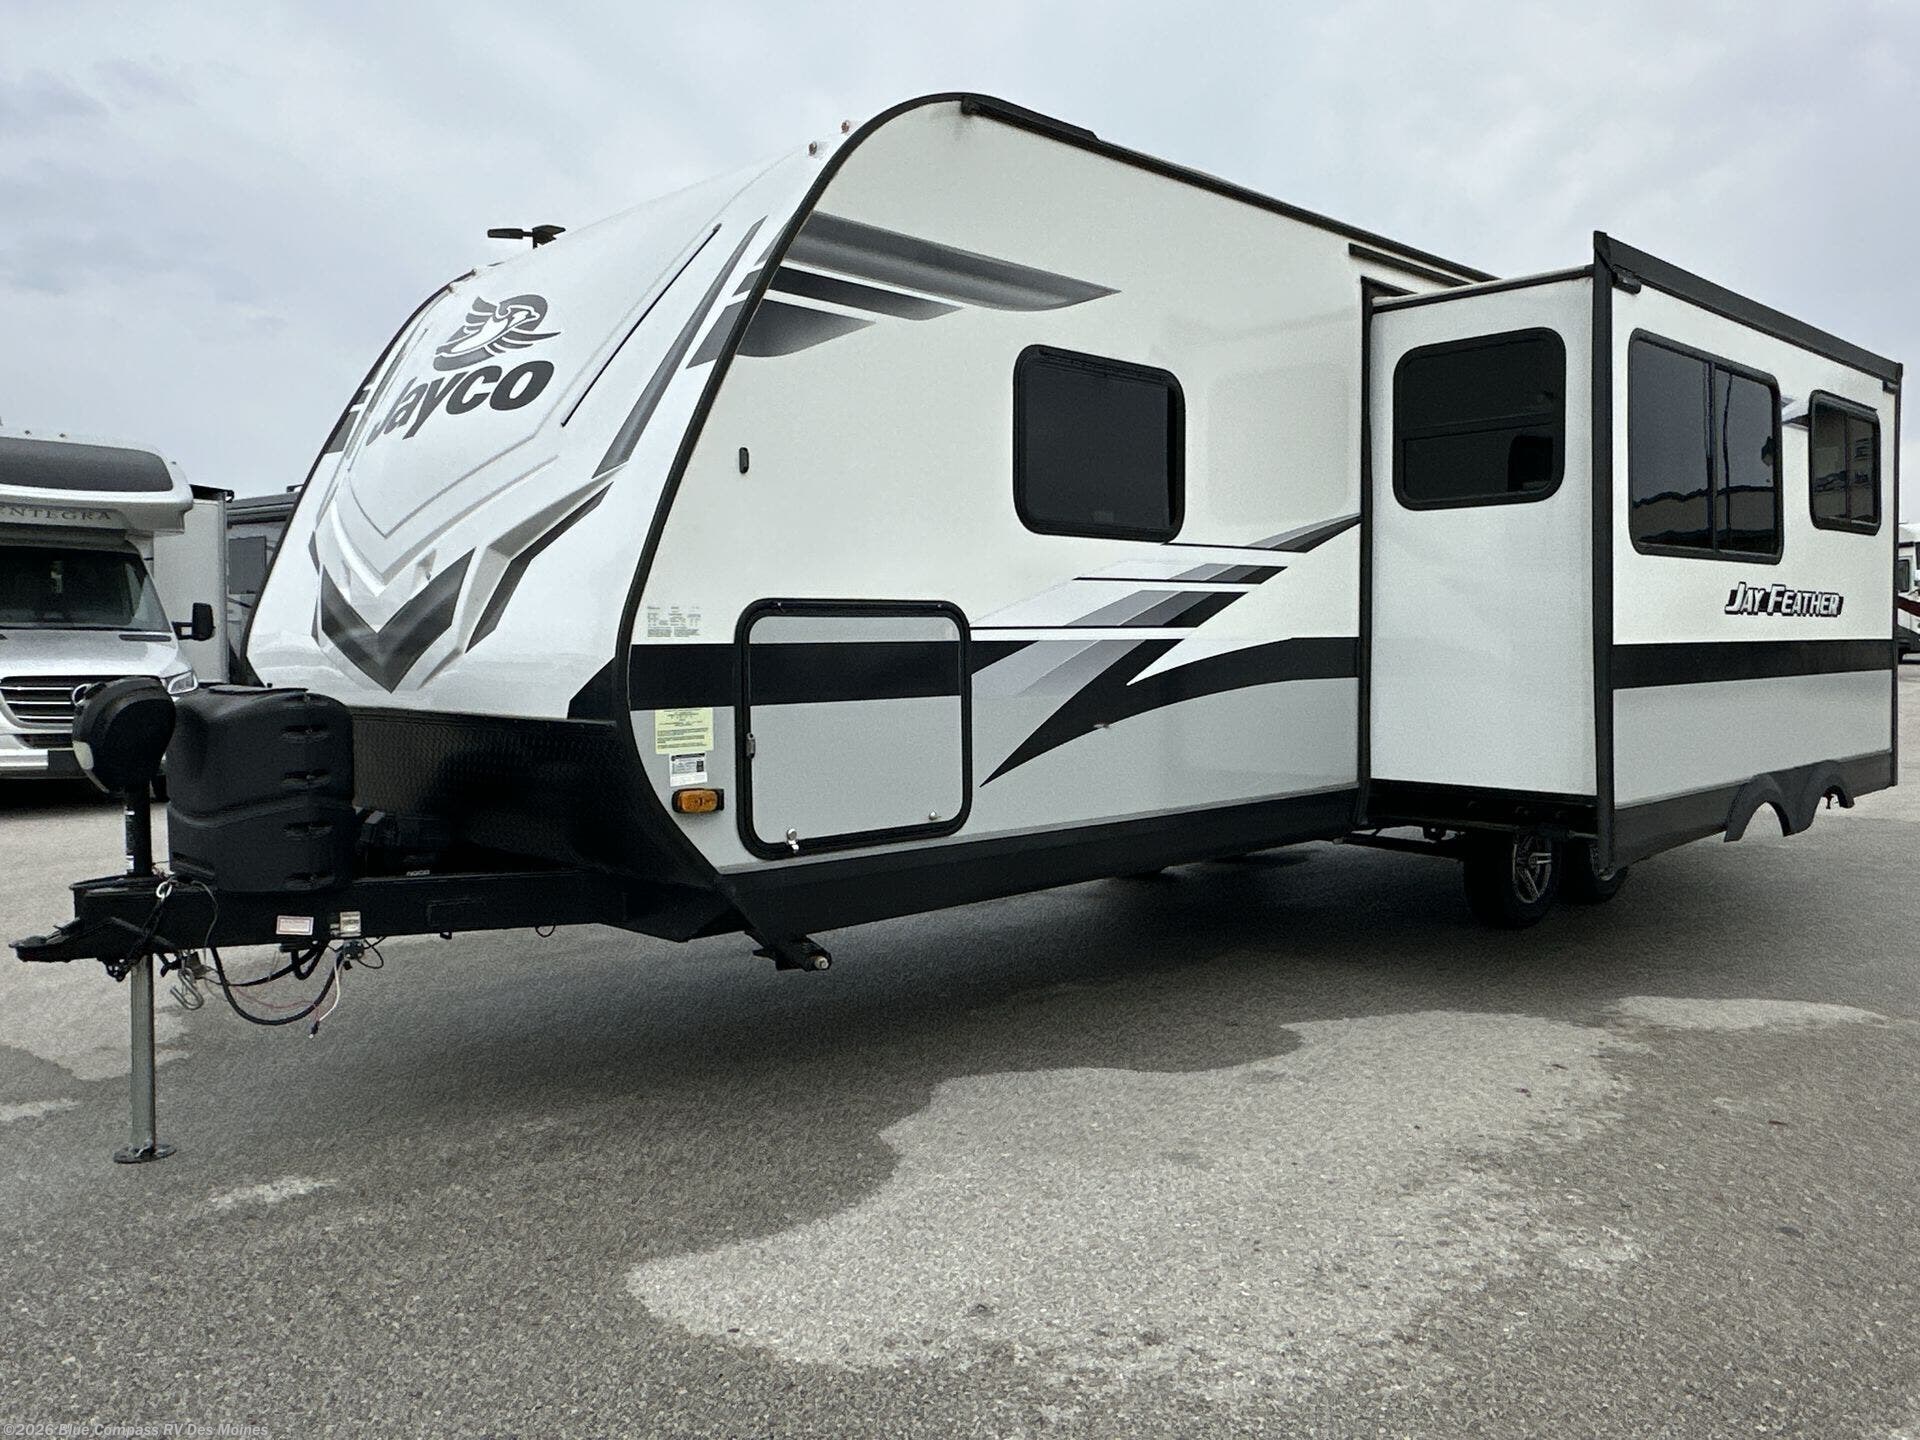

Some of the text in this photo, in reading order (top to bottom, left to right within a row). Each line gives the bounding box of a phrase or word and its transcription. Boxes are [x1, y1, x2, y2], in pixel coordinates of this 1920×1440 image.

[366, 361, 555, 446] Jayco
[1724, 581, 1844, 617] JAY FEATHER
